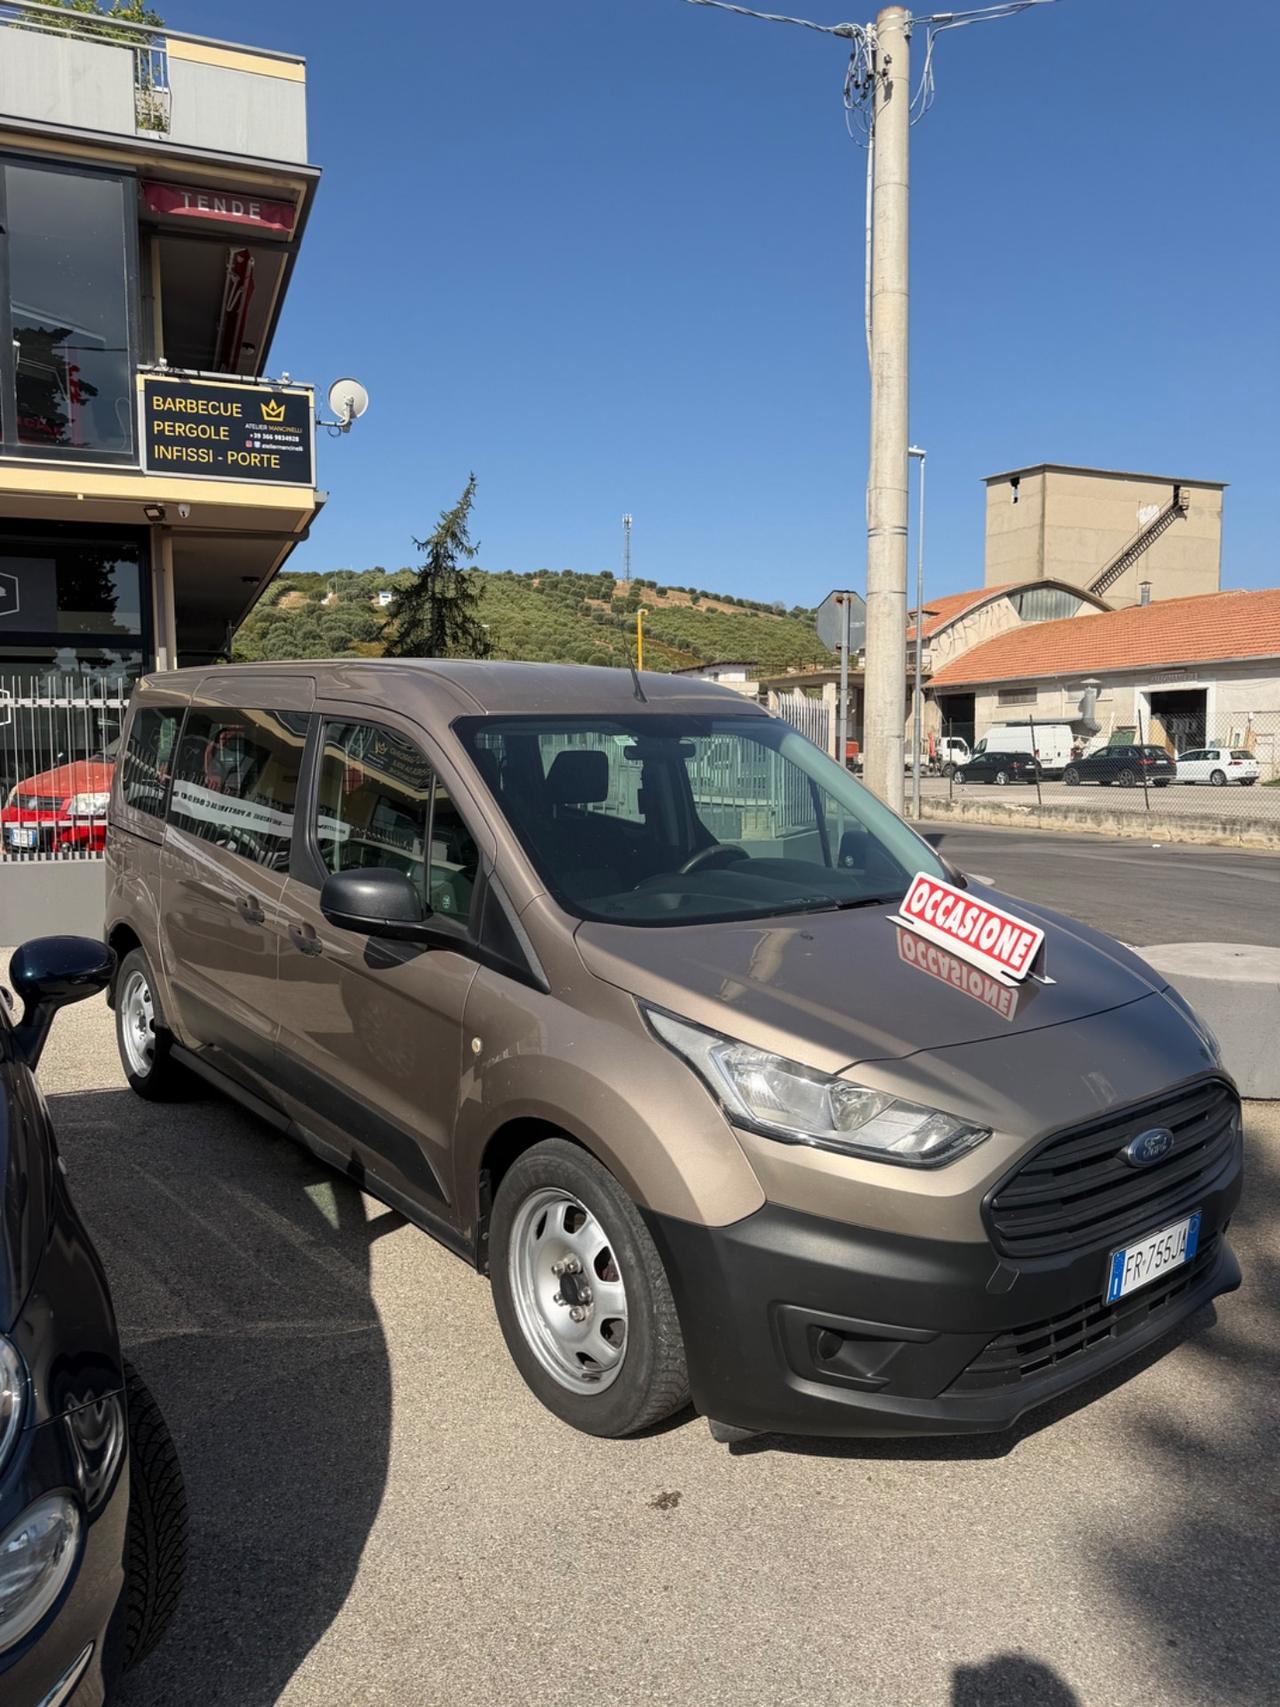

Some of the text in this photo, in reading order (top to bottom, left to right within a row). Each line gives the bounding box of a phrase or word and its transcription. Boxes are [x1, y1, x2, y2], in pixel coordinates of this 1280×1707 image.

[180, 192, 262, 219] TENDE
[152, 396, 243, 417] BARBECUE
[153, 421, 230, 440] PERGOLE
[245, 423, 303, 433] ATELIER MANCINELLI
[154, 445, 214, 463] INFISSI
[227, 451, 281, 469] PORTE
[910, 882, 1033, 968] OCCASIONE
